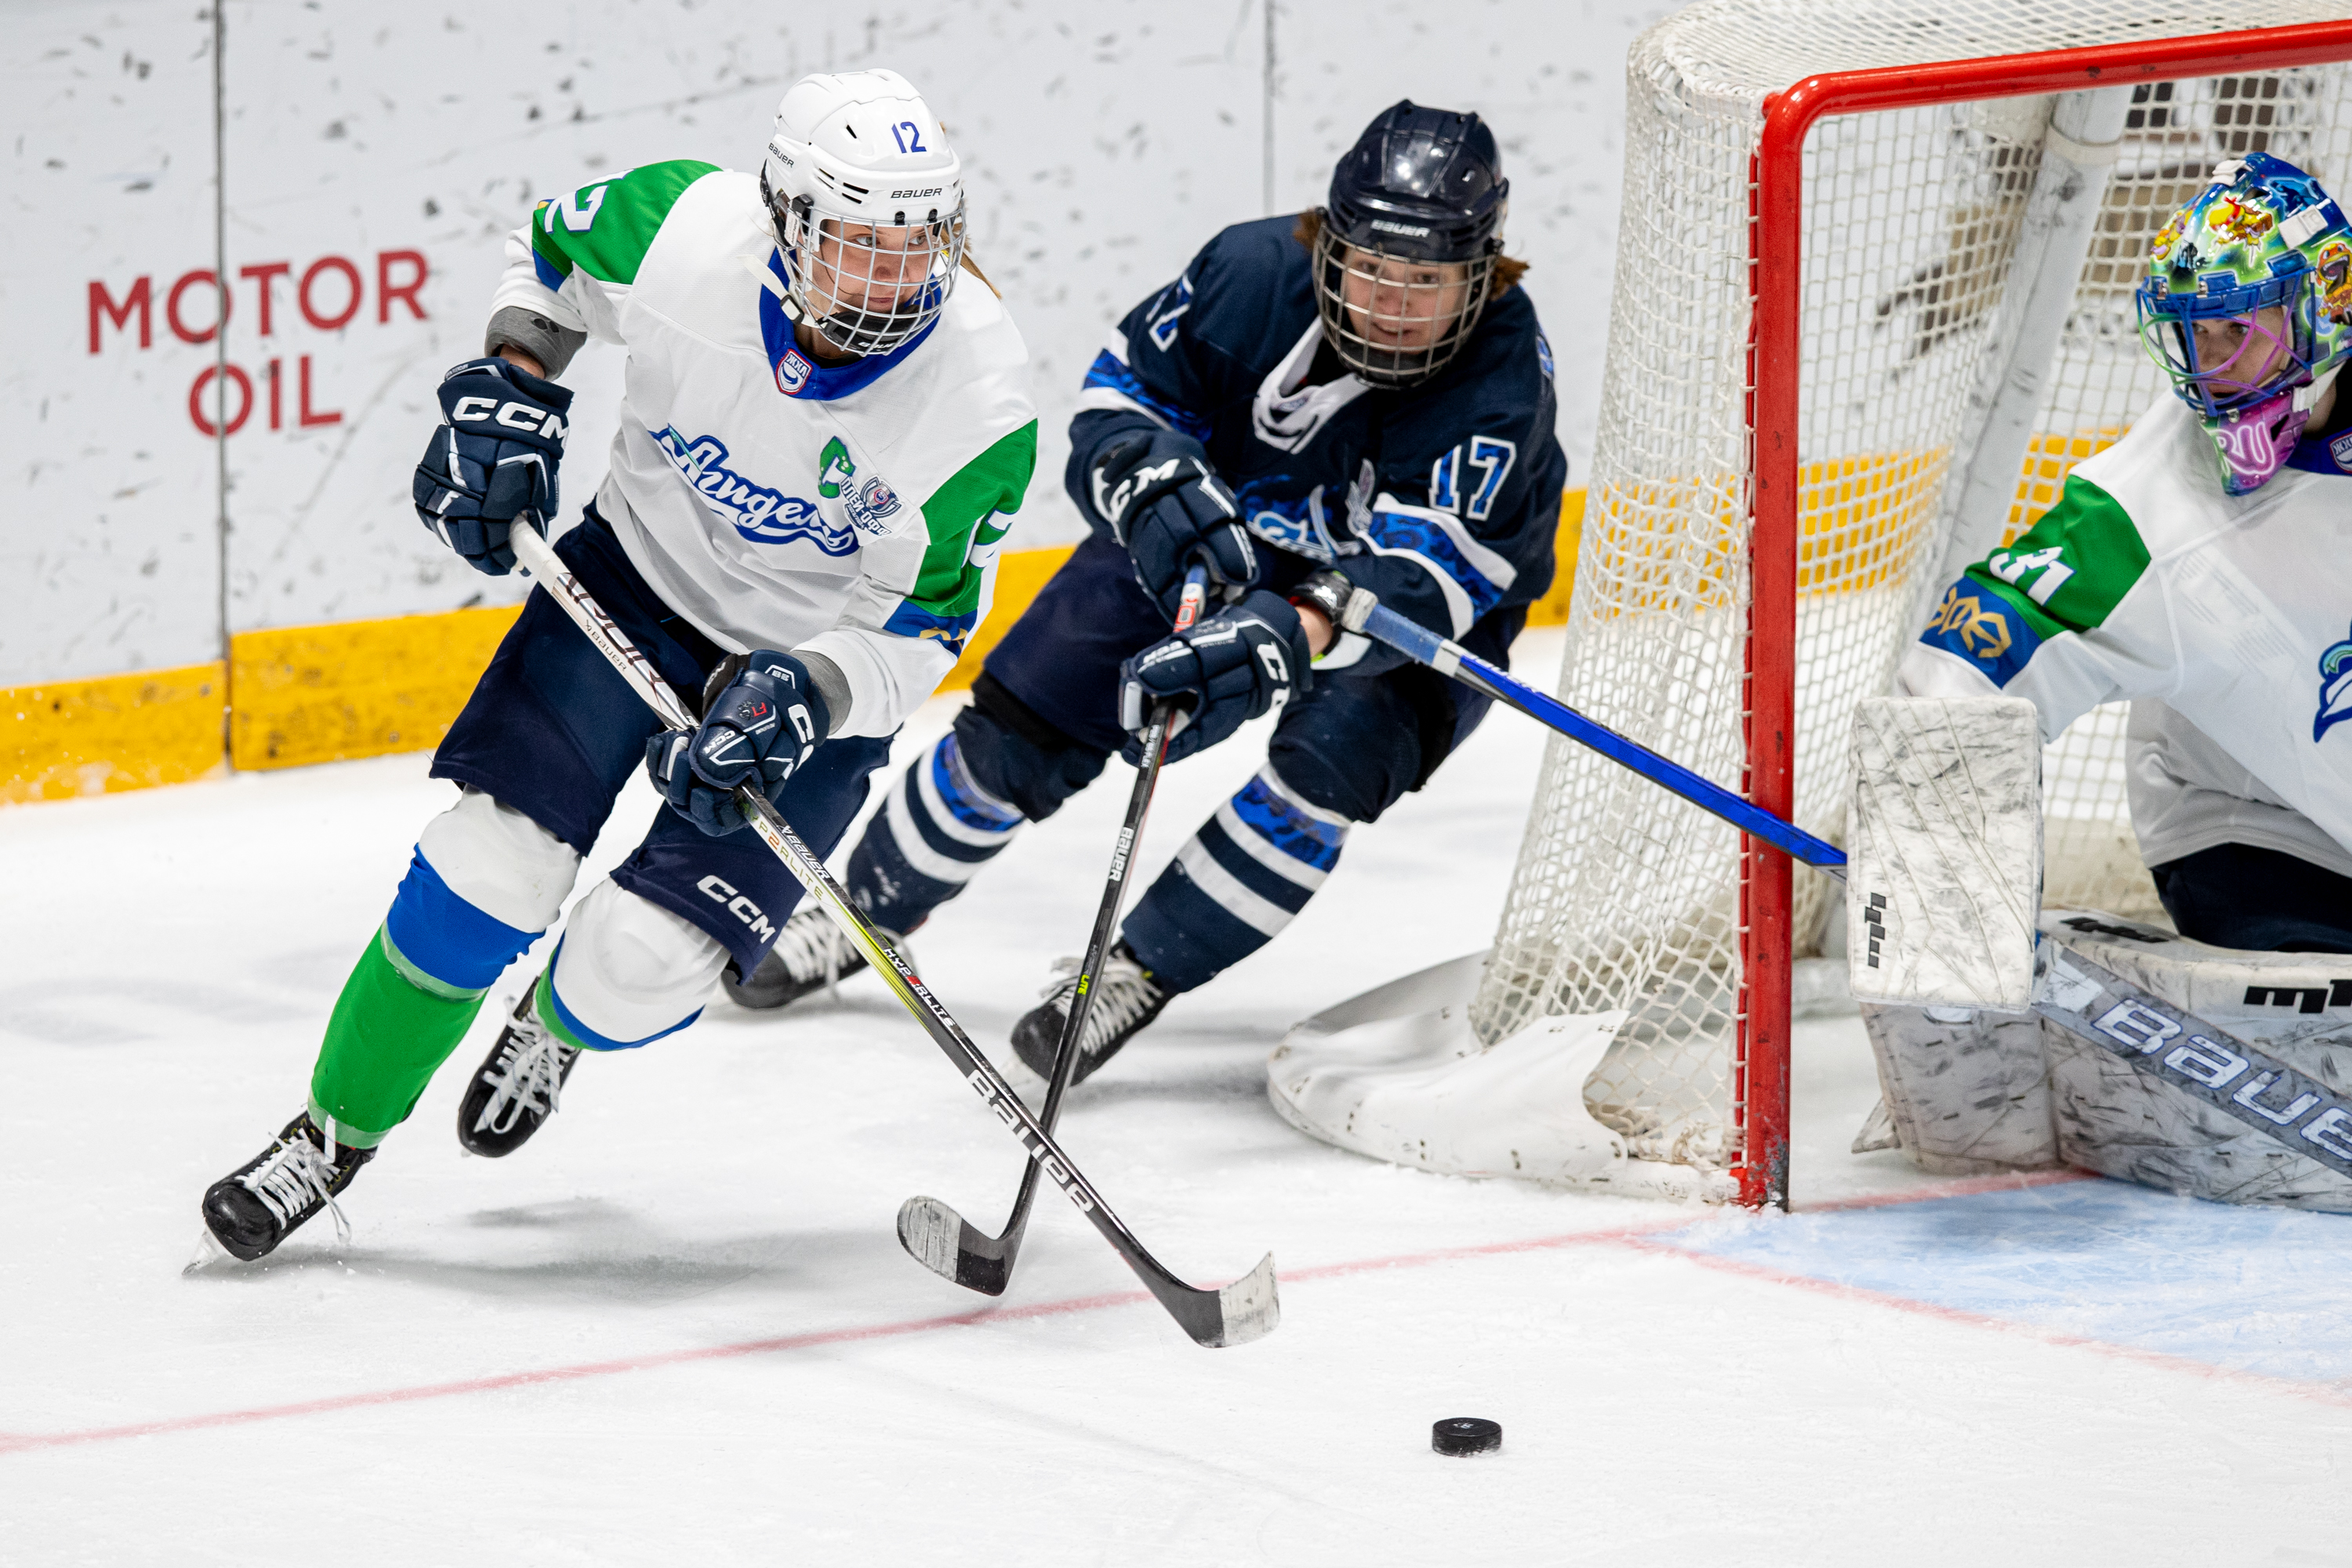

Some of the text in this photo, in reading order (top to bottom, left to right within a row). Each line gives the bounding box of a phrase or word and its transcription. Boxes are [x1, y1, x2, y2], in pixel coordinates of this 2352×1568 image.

[891, 121, 927, 154] 12
[88, 249, 430, 355] MOTOR
[188, 354, 343, 438] OIL
[452, 396, 569, 449] CCM
[1428, 435, 1519, 521] 17
[696, 875, 776, 945] CCM
